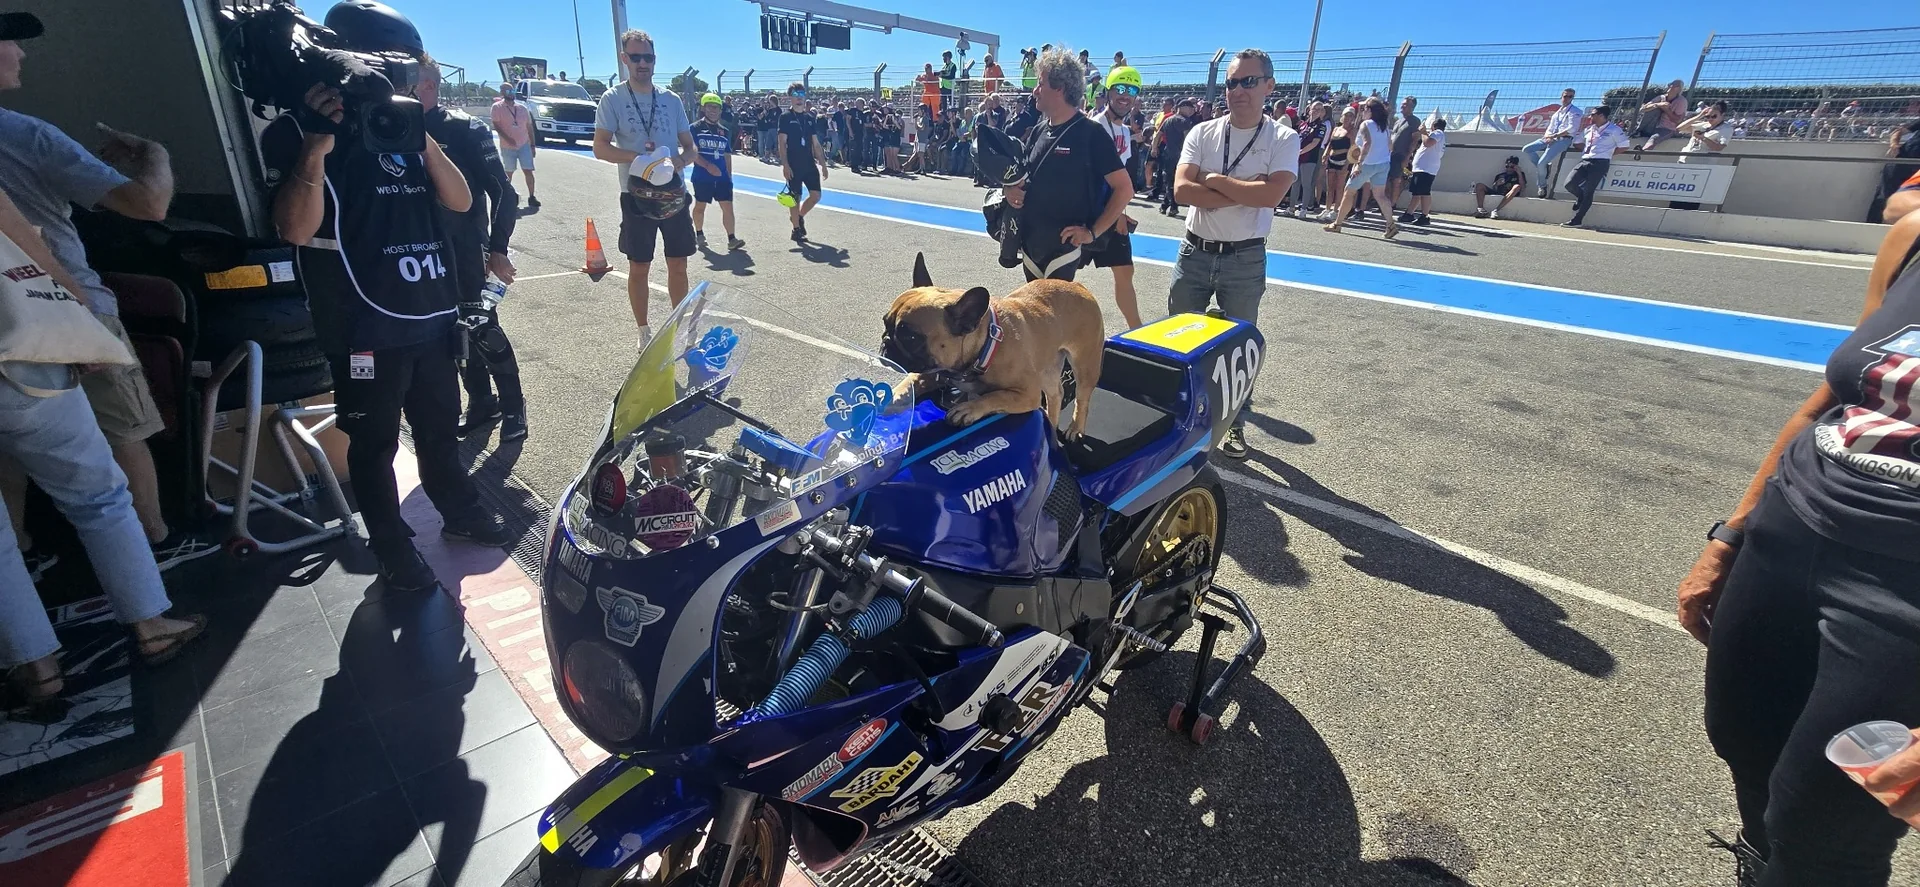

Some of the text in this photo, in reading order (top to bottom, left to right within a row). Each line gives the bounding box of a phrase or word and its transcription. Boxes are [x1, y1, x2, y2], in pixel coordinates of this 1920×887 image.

[1610, 178, 1696, 193] PAUL RICARD
[1614, 168, 1701, 181] CIRCUIT
[376, 185, 399, 195] WBD
[382, 244, 410, 255] HOST
[398, 253, 447, 282] 014
[933, 438, 1009, 471] JCH RACING
[962, 468, 1026, 514] YAMAHA
[660, 513, 696, 525] CIRCUIT
[578, 516, 627, 557] RACING
[558, 537, 593, 584] YAMAHA
[614, 604, 635, 622] FIM
[845, 724, 877, 753] KENT
[847, 756, 919, 809] BARDAHL
[546, 802, 599, 857] YAHA
